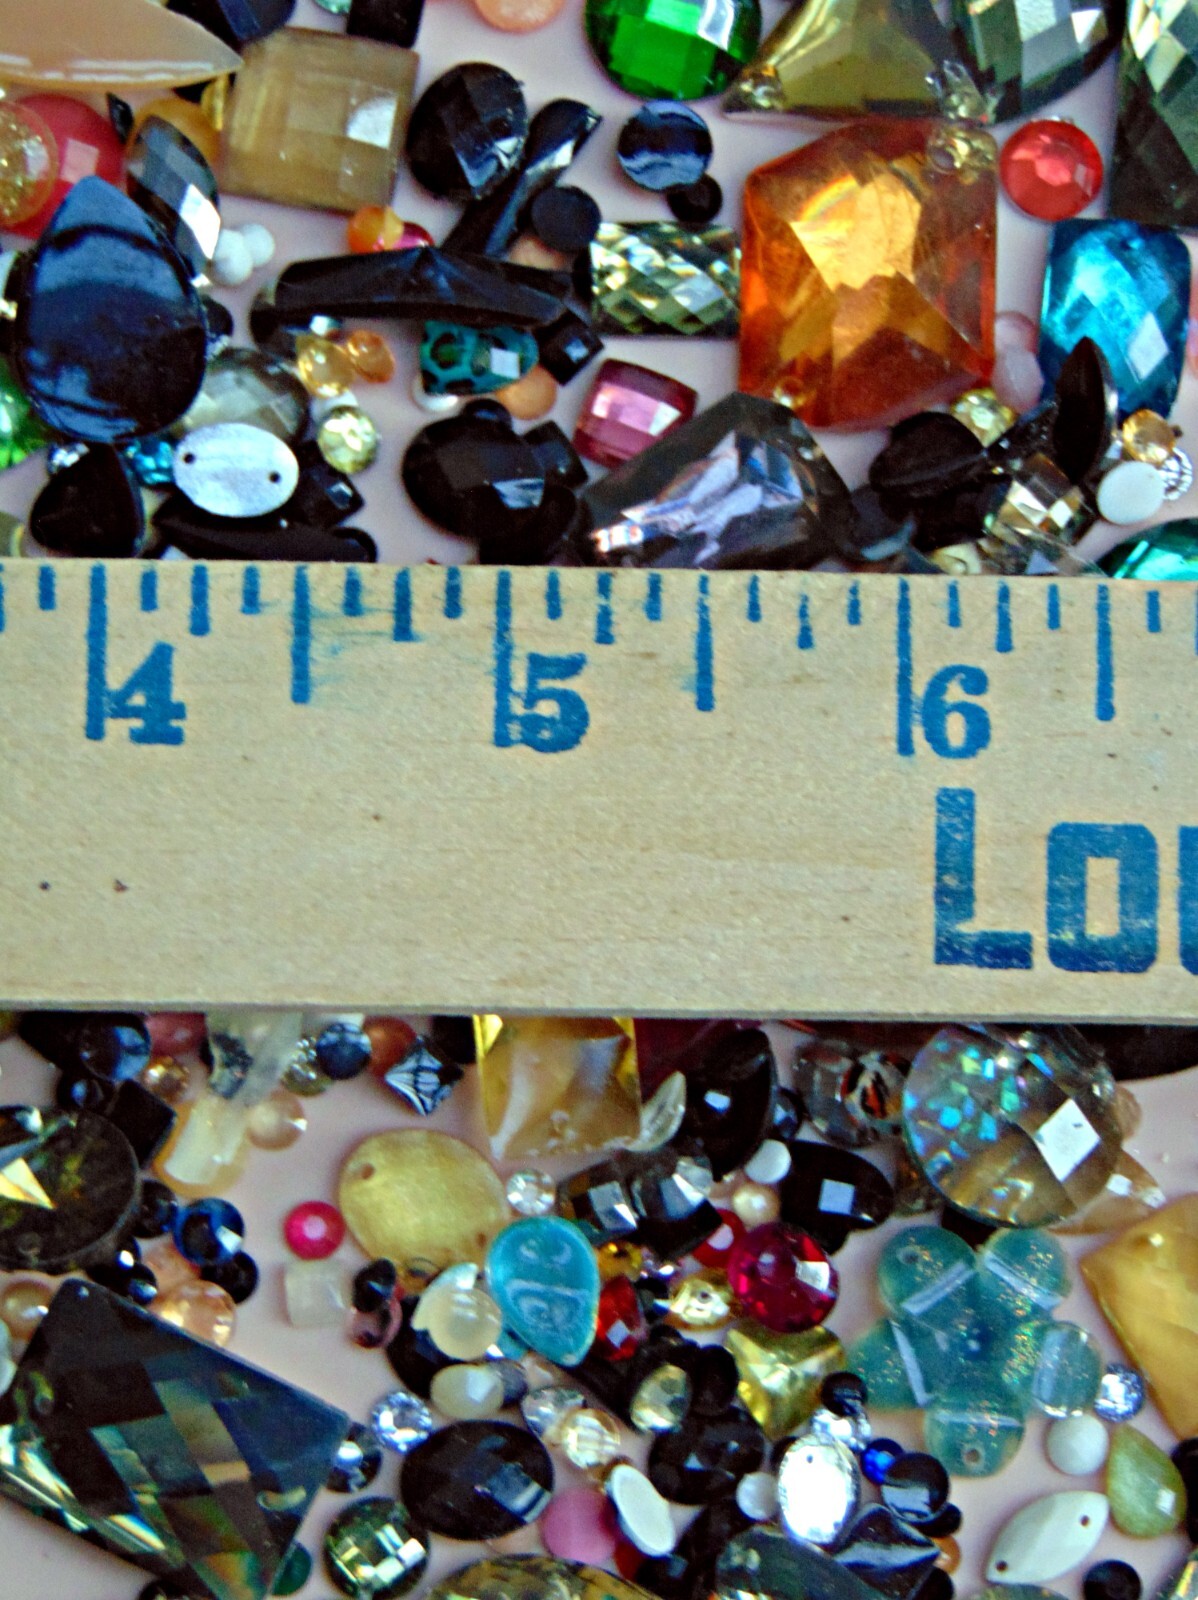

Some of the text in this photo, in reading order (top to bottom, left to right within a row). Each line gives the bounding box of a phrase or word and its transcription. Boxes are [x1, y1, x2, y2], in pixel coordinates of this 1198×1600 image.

[105, 642, 991, 759] 4 5 6
[934, 786, 1198, 975] LO
